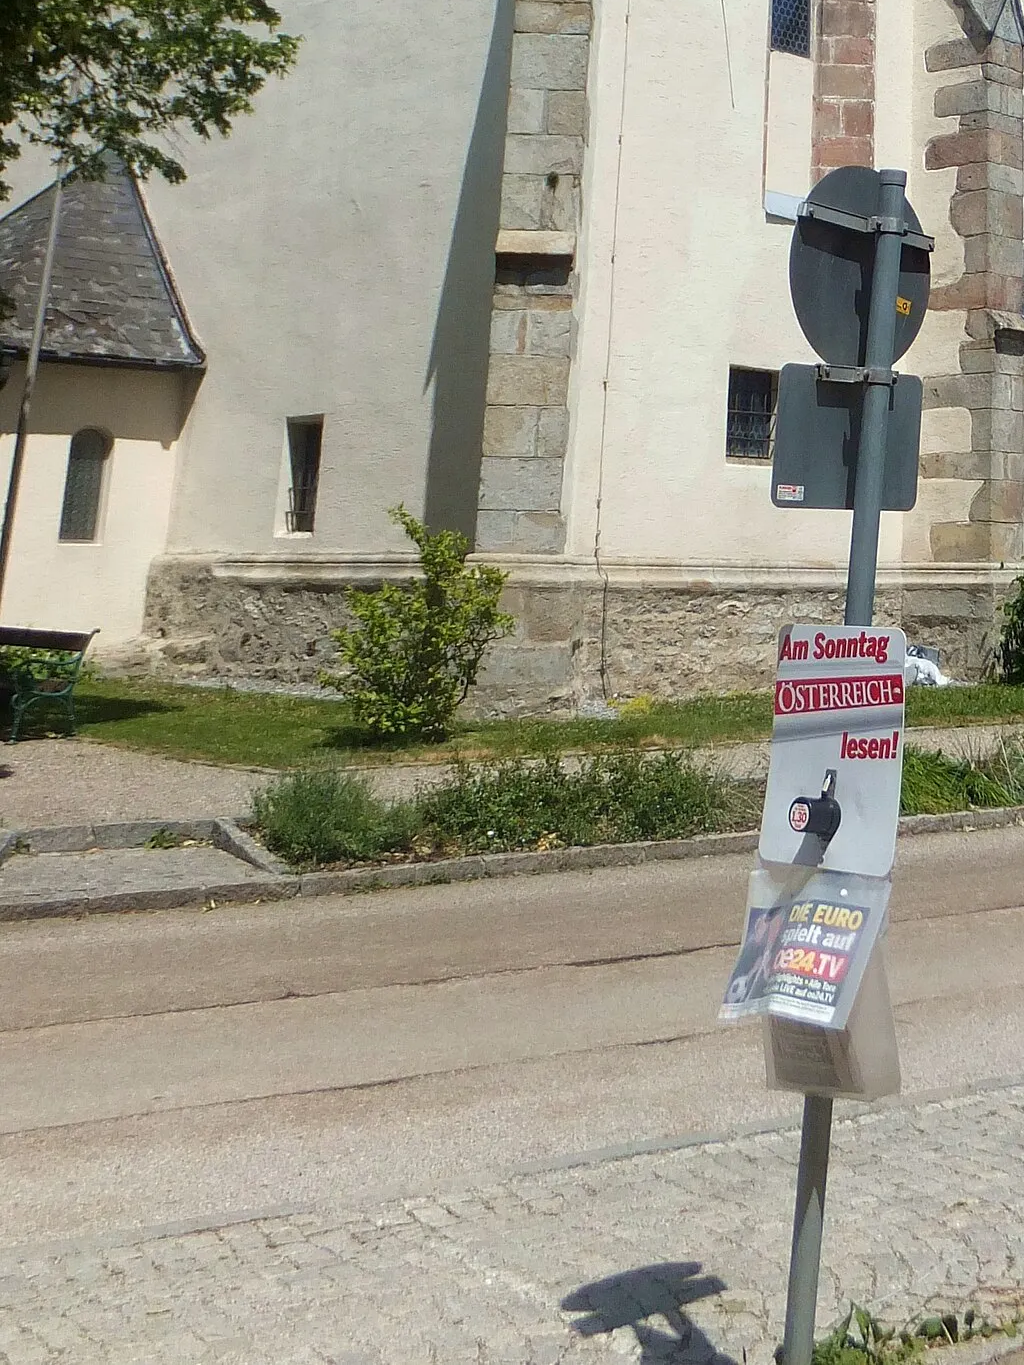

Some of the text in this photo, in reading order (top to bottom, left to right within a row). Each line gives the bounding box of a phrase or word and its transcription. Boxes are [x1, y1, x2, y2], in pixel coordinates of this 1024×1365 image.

[780, 631, 890, 664] Am Sonntag
[778, 680, 894, 713] ÖSTERREICH
[840, 731, 899, 759] lesen!
[789, 902, 863, 931] DIE EURO
[781, 923, 857, 951] spielt auf
[773, 948, 845, 978] oe24.TV
